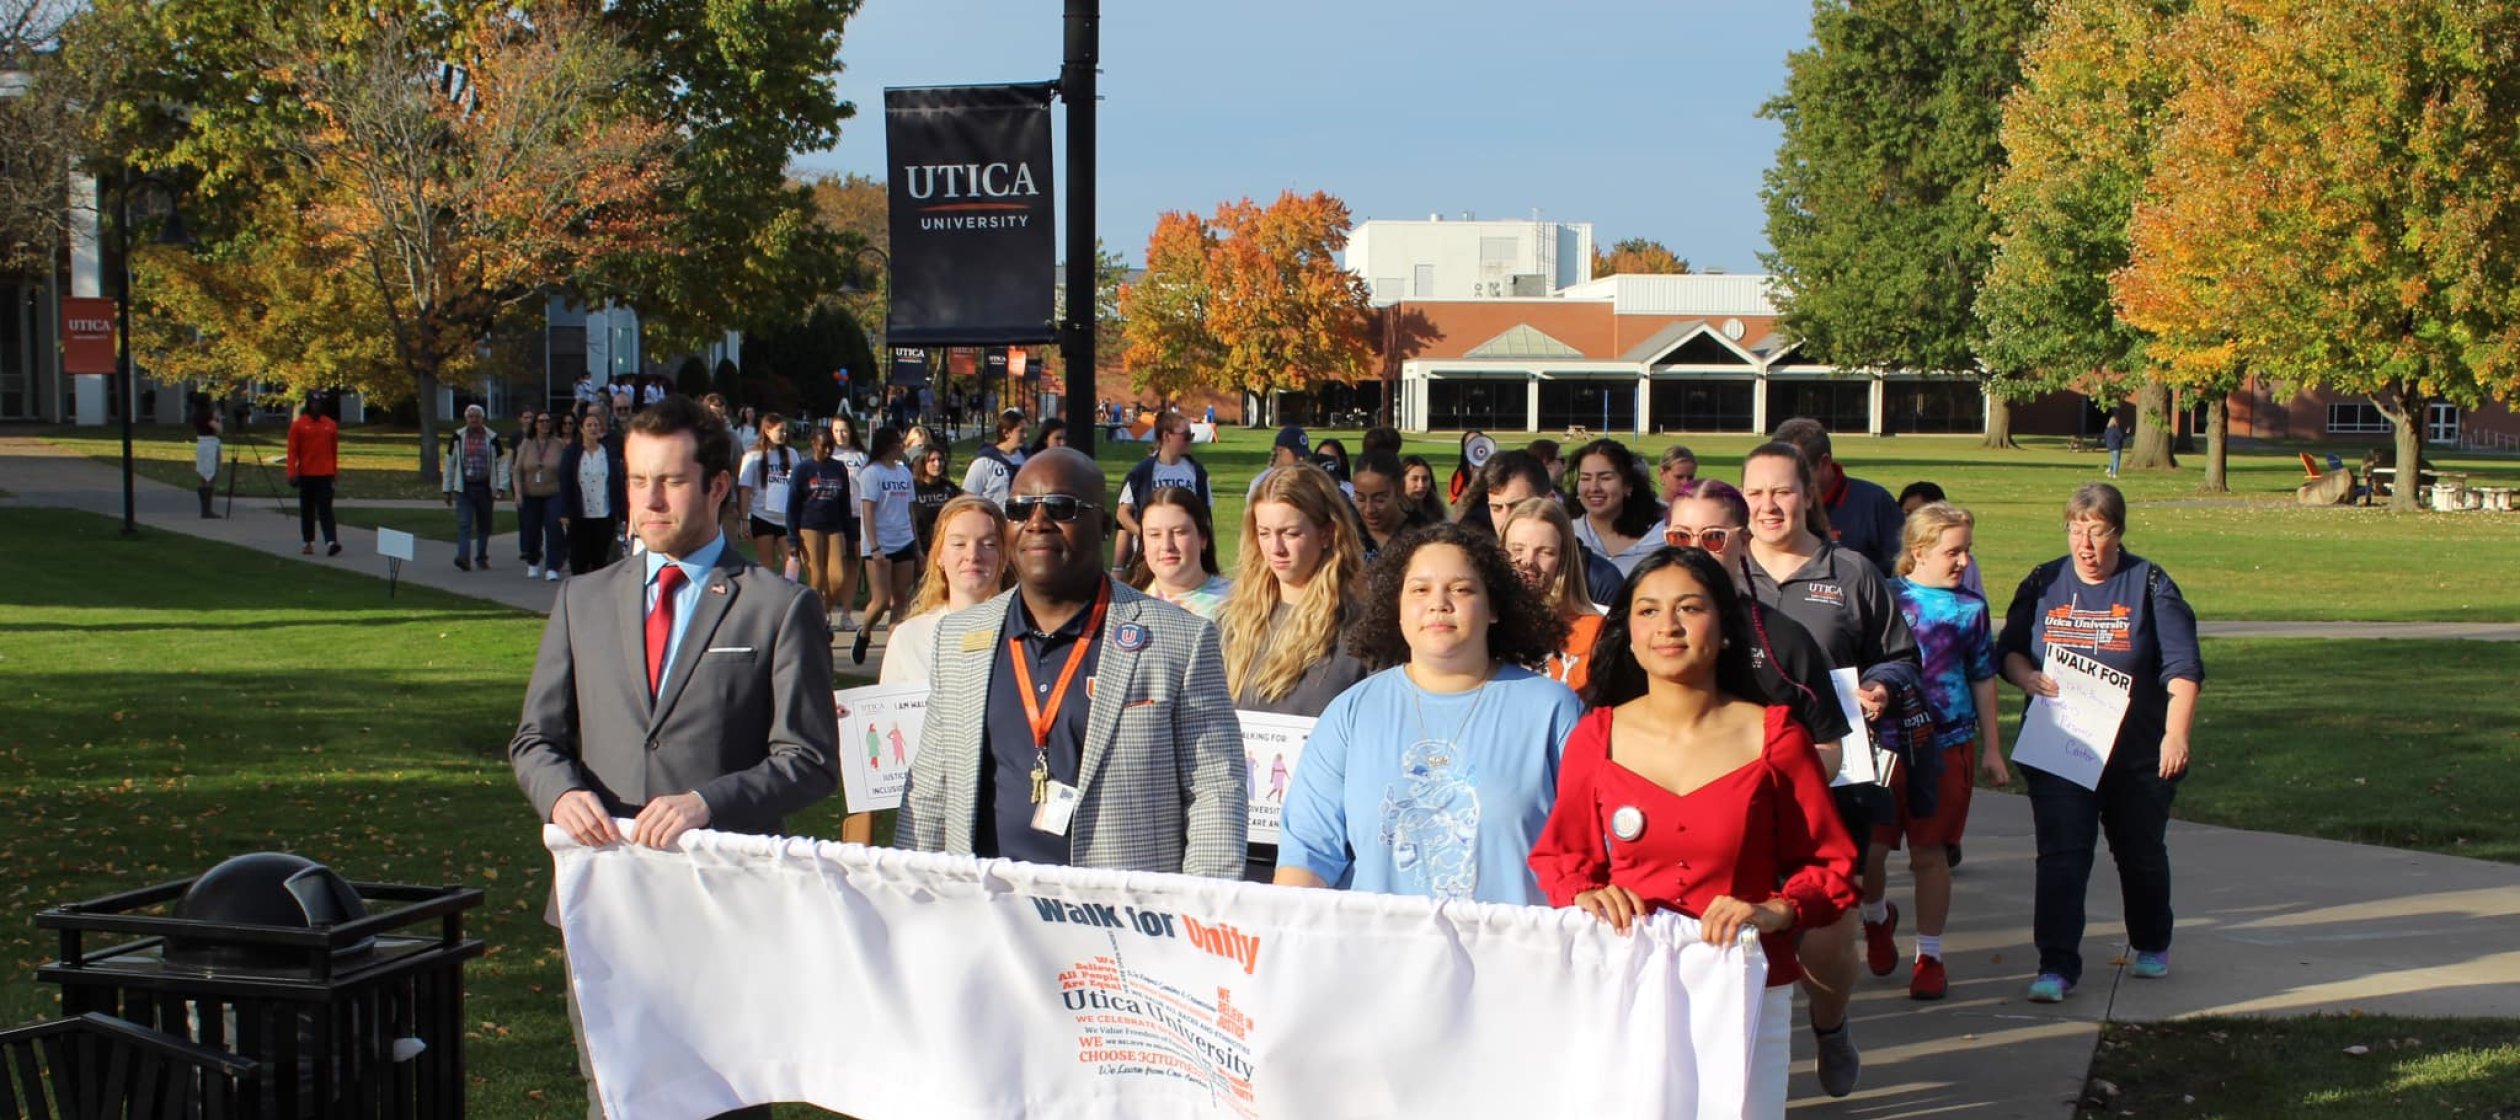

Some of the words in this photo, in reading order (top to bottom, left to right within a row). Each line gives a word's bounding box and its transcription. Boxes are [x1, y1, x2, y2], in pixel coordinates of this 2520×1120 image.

[904, 161, 1040, 199] UTICA
[920, 215, 1029, 231] UNIVERSITY
[68, 319, 111, 332] UTICA
[895, 347, 925, 358] UTICA
[1809, 582, 1843, 596] UTICA
[2044, 616, 2072, 627] Utica
[2074, 619, 2131, 632] University
[2047, 644, 2054, 658] I
[2055, 648, 2099, 677] WALK
[2100, 667, 2130, 691] FOR
[1241, 731, 1270, 742] ALKING
[1248, 805, 1281, 815] DIVERSIT
[1027, 896, 1125, 928] Walk
[1124, 905, 1176, 938] for
[1181, 913, 1260, 975] Unity
[1060, 989, 1142, 1015] Utica
[1145, 1000, 1254, 1083] University
[1078, 1036, 1103, 1048] WE
[1079, 1049, 1137, 1063] CHOOSE
